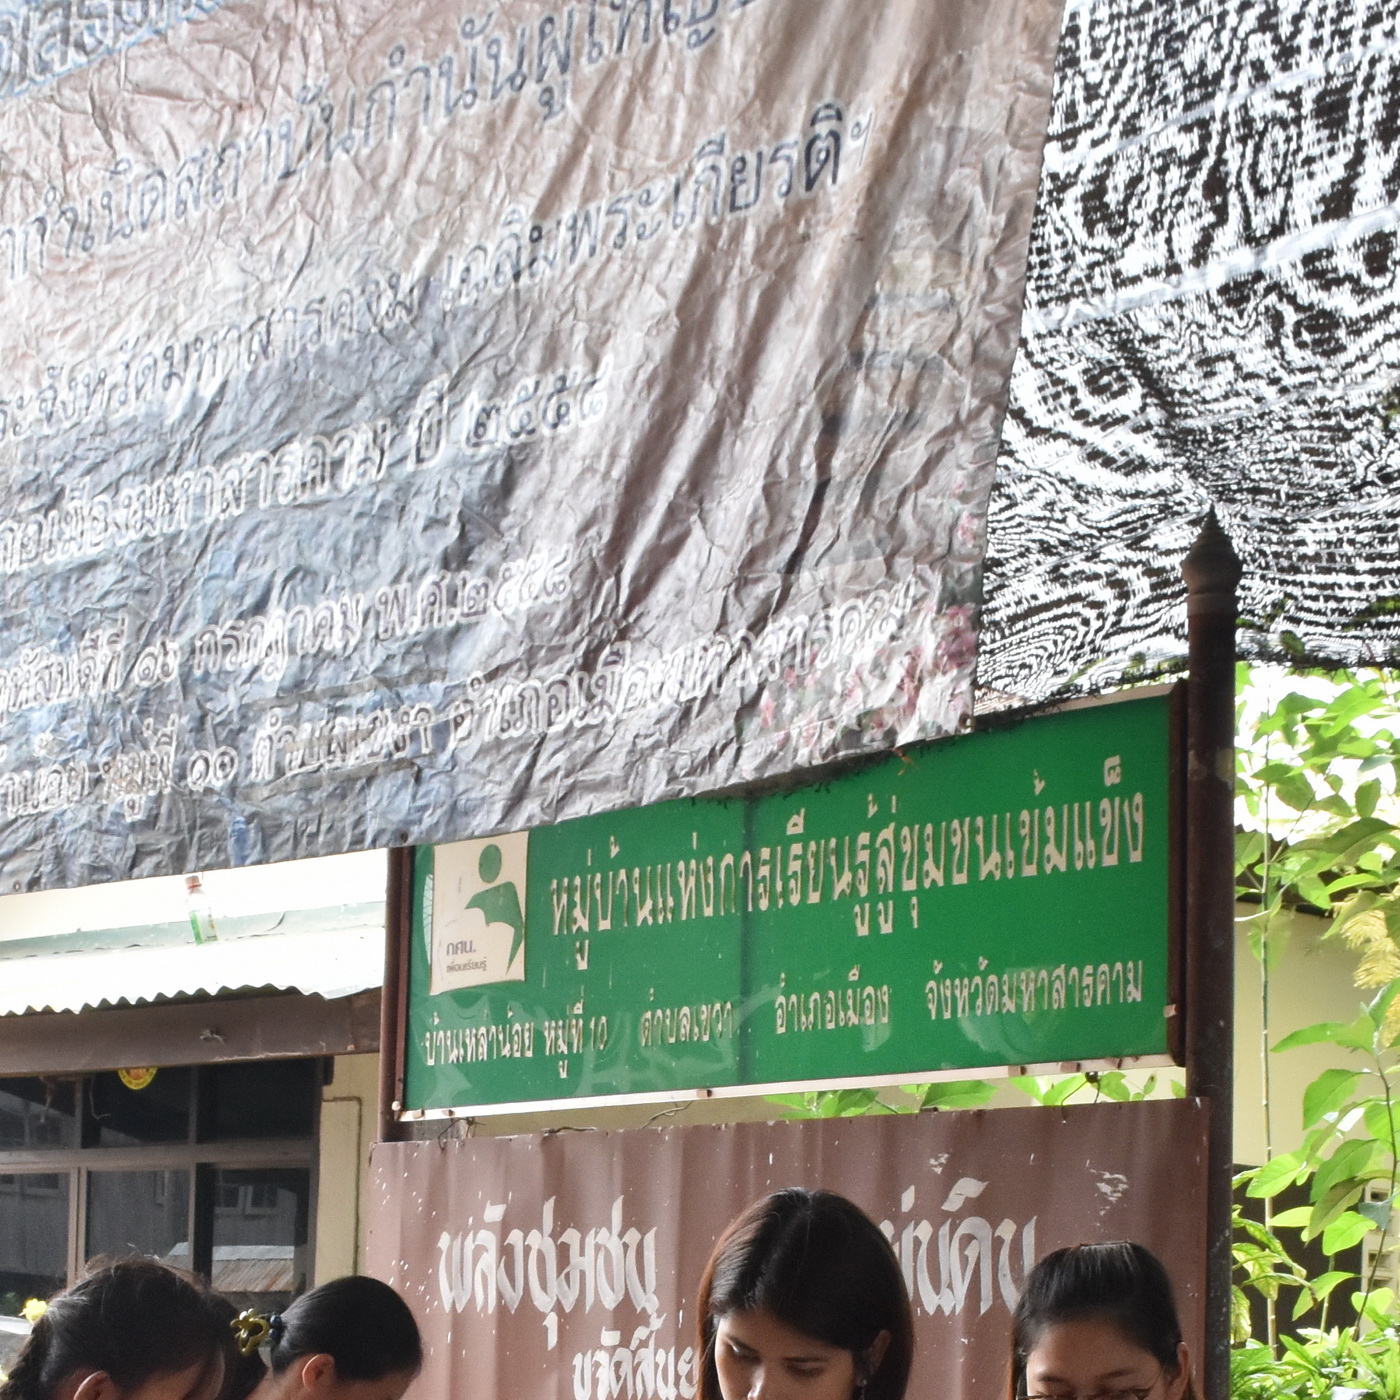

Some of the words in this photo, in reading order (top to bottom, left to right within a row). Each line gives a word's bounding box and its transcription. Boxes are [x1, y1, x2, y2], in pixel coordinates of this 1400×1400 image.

[447, 940, 477, 956] กศน.
[425, 1004, 534, 1066] บ้านเหล่าน้อย
[775, 964, 891, 1034] อำเภอเมือง
[925, 956, 1143, 1020] จังหวัดมหาสารคาม
[437, 1195, 659, 1351] พลังชุมชน
